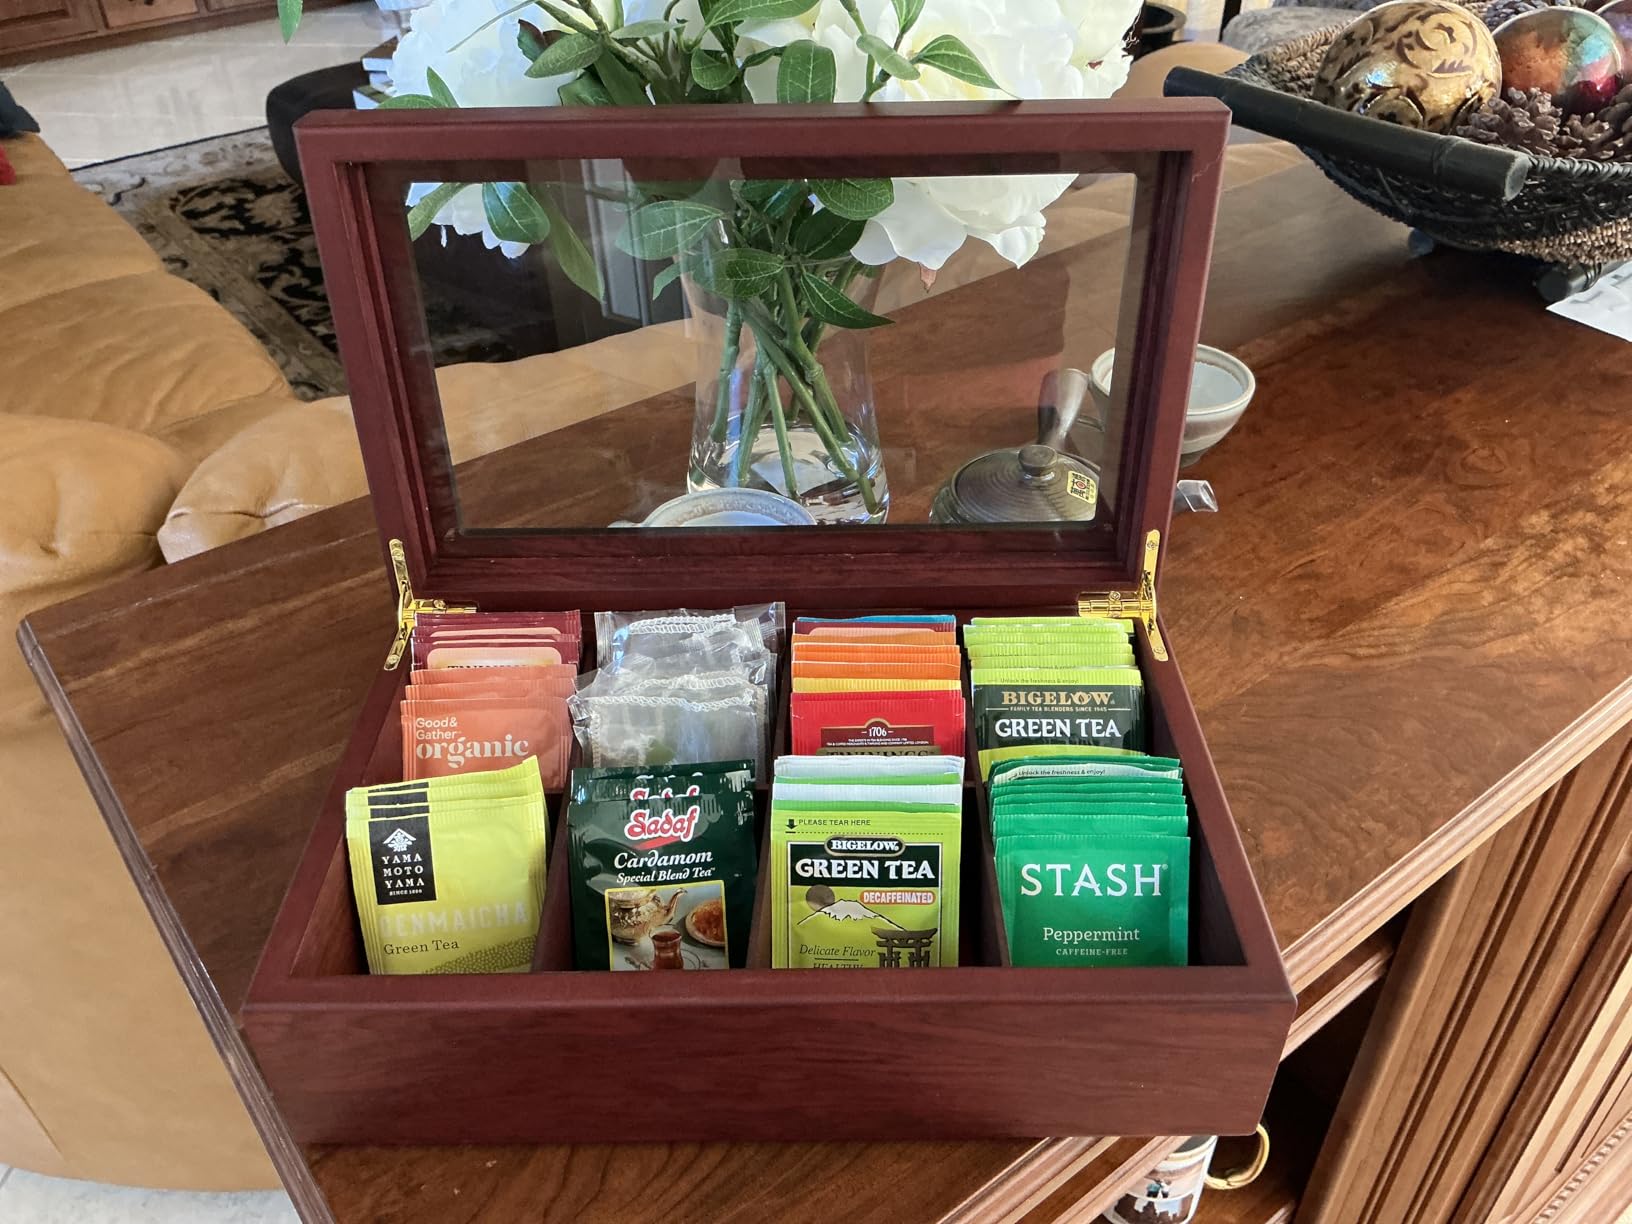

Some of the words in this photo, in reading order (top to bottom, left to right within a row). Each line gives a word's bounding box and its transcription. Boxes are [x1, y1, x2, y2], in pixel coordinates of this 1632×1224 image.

[1001, 691, 1113, 705] BIGELOW
[415, 729, 457, 740] Gather
[868, 726, 887, 737] 1706
[994, 718, 1071, 738] GREEN
[1076, 718, 1122, 738] TEA
[416, 734, 529, 769] organic
[625, 805, 699, 841] Sadaf
[830, 839, 898, 851] BIGELOW
[382, 853, 422, 865] YAMA
[614, 850, 713, 869] Cardamom
[383, 865, 424, 877] MOTO
[617, 870, 655, 885] Special
[657, 868, 690, 881] Blend
[795, 859, 879, 879] GREEN
[884, 860, 935, 879] TEA
[385, 878, 424, 889] YAMA
[1020, 863, 1162, 896] STASH
[863, 891, 933, 903] DECAFFEINATED
[1043, 927, 1140, 945] Peppermint
[384, 943, 428, 955] Green
[432, 939, 459, 950] Tea
[800, 944, 839, 956] Delicate
[843, 945, 876, 957] Flavor
